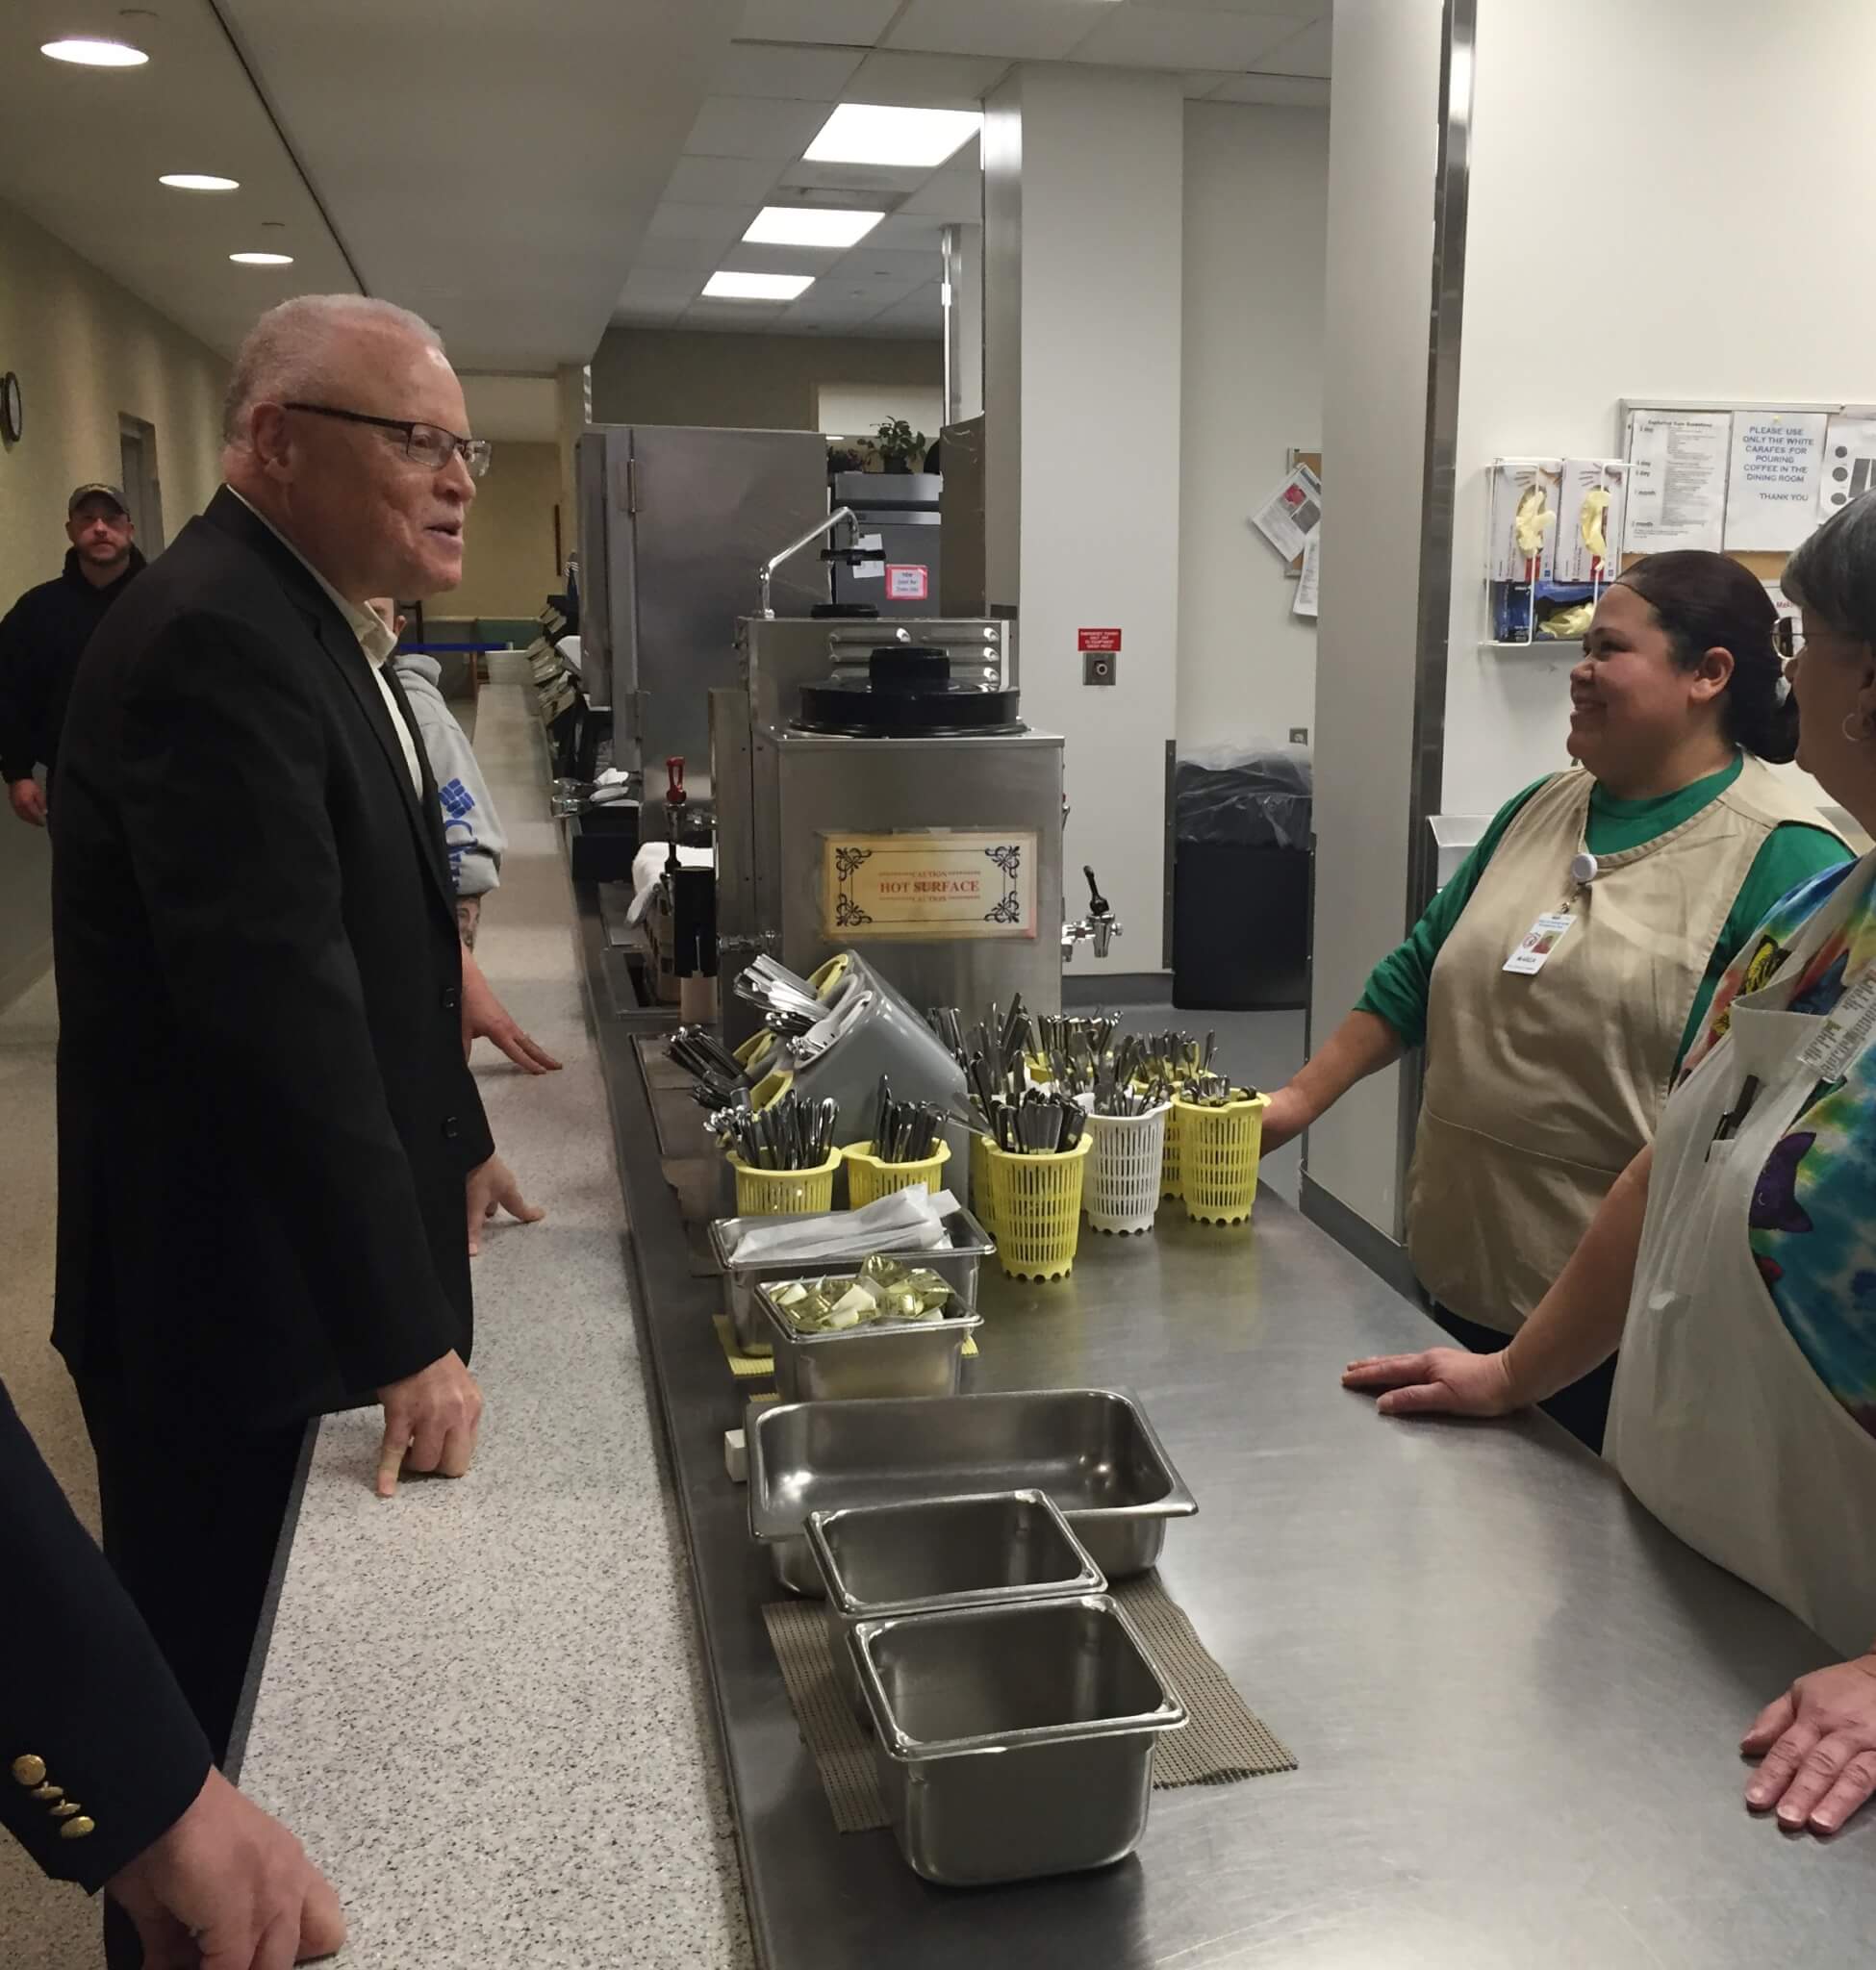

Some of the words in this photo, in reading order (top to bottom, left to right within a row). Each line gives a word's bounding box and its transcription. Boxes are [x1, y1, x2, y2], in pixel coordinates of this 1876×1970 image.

[1749, 426, 1784, 435] PLEASE
[1755, 455, 1794, 464] POURING
[1743, 464, 1778, 472] COFFEE
[1746, 473, 1778, 482] DINING
[879, 882, 911, 893] HOT
[914, 880, 979, 893] SURFACE
